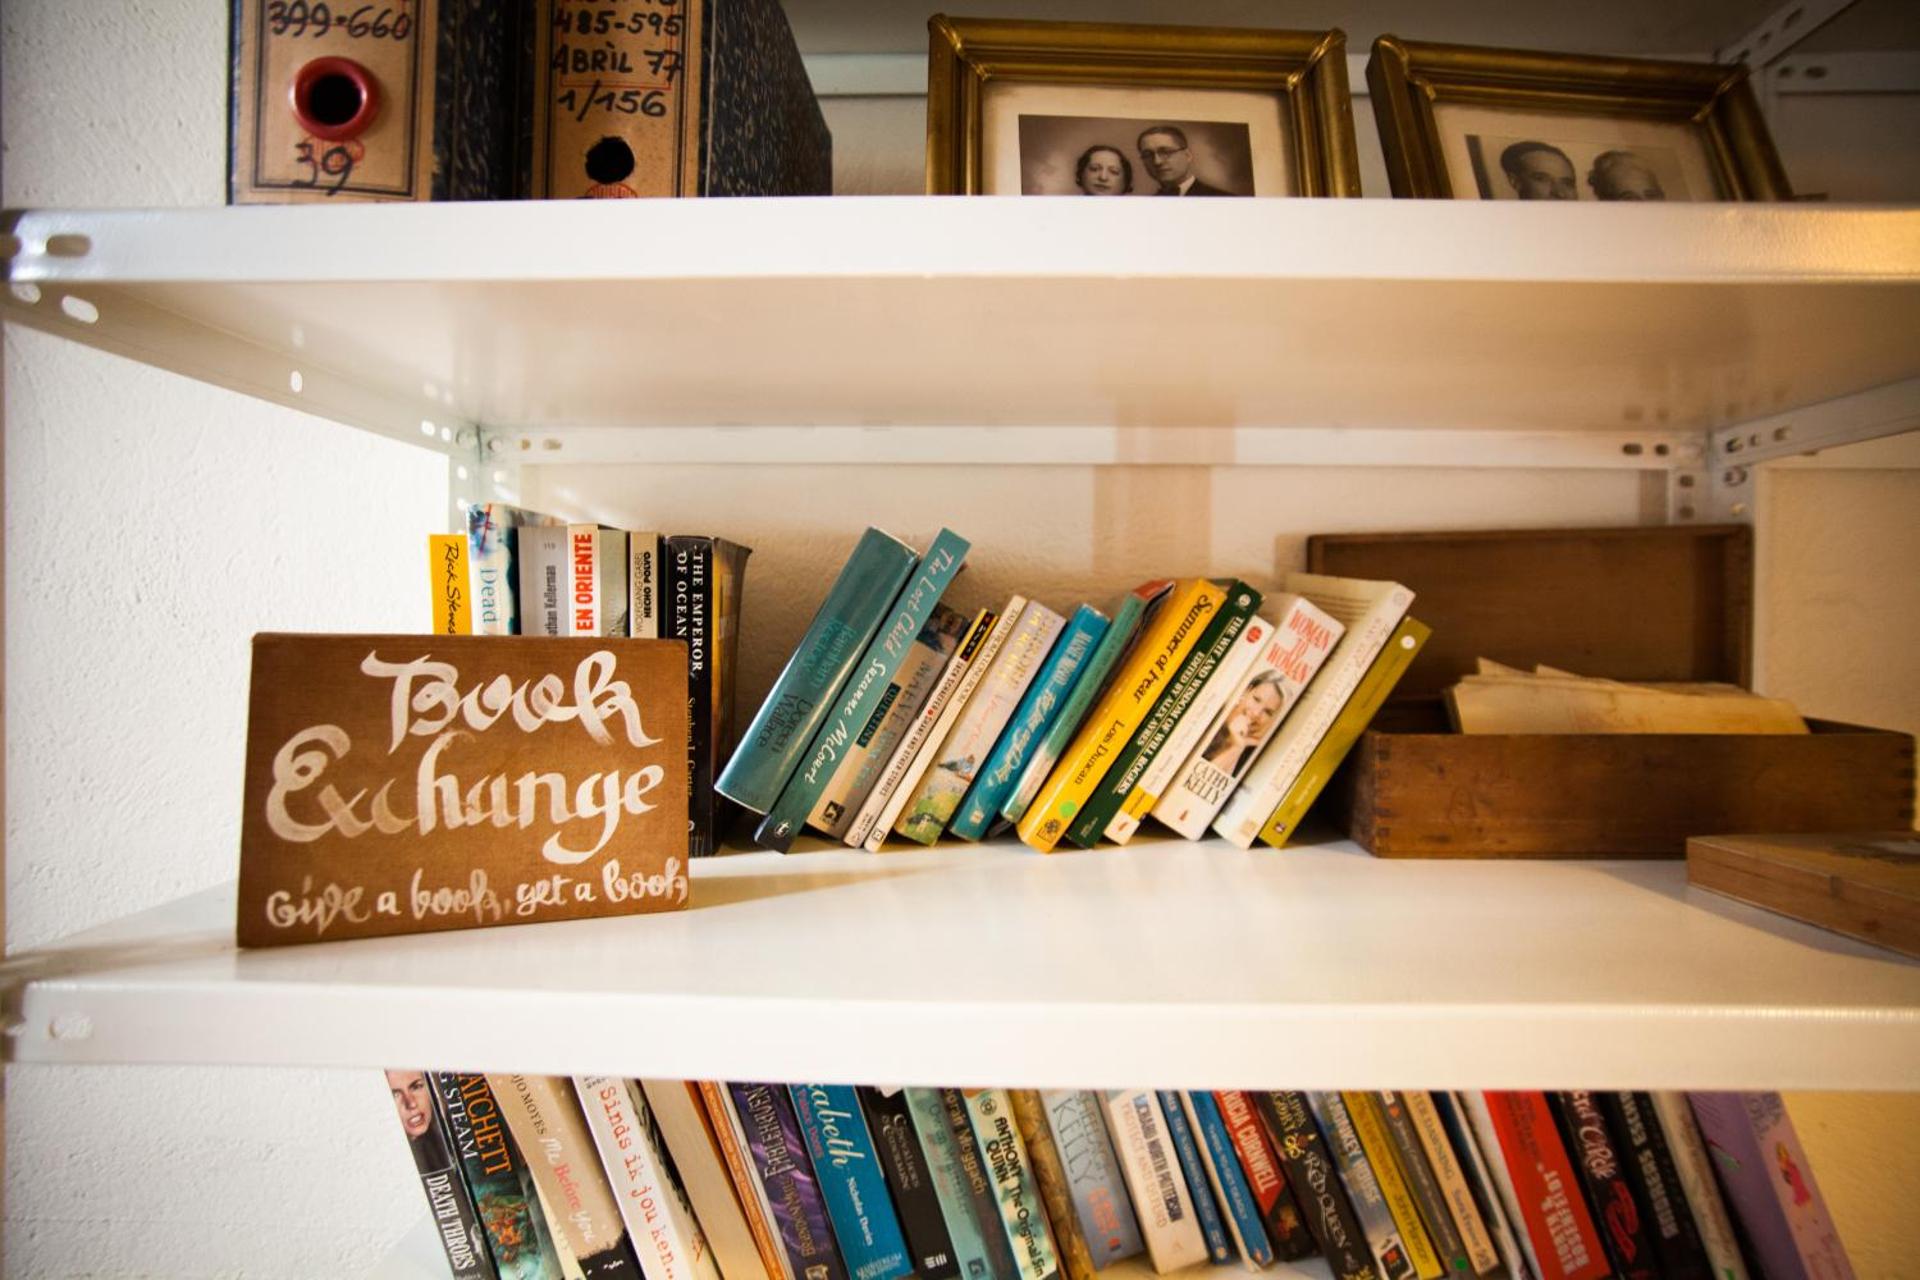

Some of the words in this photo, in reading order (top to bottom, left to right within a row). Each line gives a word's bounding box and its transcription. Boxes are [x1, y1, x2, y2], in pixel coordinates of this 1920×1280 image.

[268, 0, 412, 41] 399-660
[553, 8, 684, 36] 485-595
[643, 49, 682, 83] 77
[558, 79, 667, 122] 1/156
[293, 142, 354, 196] 39
[442, 541, 460, 582] Rick
[575, 533, 593, 604] ORIENTE
[642, 551, 651, 583] POLVO
[676, 551, 686, 574] OF
[692, 552, 702, 586] THE
[927, 547, 954, 577] The
[480, 568, 497, 622] Dead
[541, 565, 557, 608] Kellerman
[642, 586, 652, 617] HECHO
[905, 576, 936, 613] Lost
[576, 608, 593, 630] EN
[634, 581, 644, 632] WOLFGANG
[676, 580, 686, 636] OCEAN
[1165, 593, 1214, 657] Summer
[1225, 615, 1243, 637] THE
[880, 612, 916, 655] Child
[1212, 635, 1230, 656] WIT
[1288, 611, 1334, 652] WOMAN
[1153, 654, 1169, 671] of
[1178, 650, 1204, 683] EDITED
[1197, 655, 1216, 678] AND
[1266, 645, 1311, 684] WOMAN
[361, 650, 664, 754] Book
[842, 658, 886, 719] Suzanne
[930, 676, 954, 710] SCHAEFER
[1154, 695, 1174, 720] ALEX
[1169, 682, 1182, 696] BY
[1169, 678, 1201, 717] WISDOM
[756, 690, 796, 749] Wallace
[772, 697, 812, 756] Doreen
[914, 714, 931, 737] SHANE
[1101, 718, 1124, 745] Lois
[1135, 718, 1158, 746] AYRES
[1158, 717, 1174, 734] OF
[803, 720, 850, 786] McCourt
[894, 749, 910, 770] OTHER
[906, 736, 919, 750] AND
[1143, 732, 1163, 757] WILL
[878, 770, 898, 797] STORIES
[1073, 744, 1108, 786] Duncan
[1116, 755, 1147, 794] ROGERS
[1191, 761, 1232, 793] CATHY
[266, 724, 665, 865] Exchange
[1182, 774, 1227, 806] KELLY
[266, 876, 370, 935] Give
[377, 892, 401, 915] a
[516, 877, 571, 915] get
[575, 883, 596, 902] a
[602, 856, 688, 904] book
[442, 1085, 479, 1160] STEAM
[520, 1093, 547, 1134] MOYES
[597, 1086, 636, 1149] Sinds
[746, 1084, 795, 1179] FABLEHAVEN
[538, 1132, 565, 1164] Me
[953, 1129, 987, 1194] Moggach
[985, 1140, 1009, 1182] QUINN
[994, 1117, 1022, 1177] ANTHONY
[1050, 1100, 1097, 1186] KELLY
[1236, 1126, 1278, 1192] CORNWELL
[552, 1162, 586, 1210] Before
[623, 1153, 647, 1181] ik
[425, 1173, 459, 1219] DEATH
[630, 1184, 662, 1223] jou
[844, 1177, 866, 1215] Nicholas
[1008, 1184, 1026, 1207] The
[439, 1218, 476, 1271] THROES
[568, 1208, 600, 1246] You
[1013, 1208, 1040, 1257] Original
[1031, 1257, 1047, 1277] Sin
